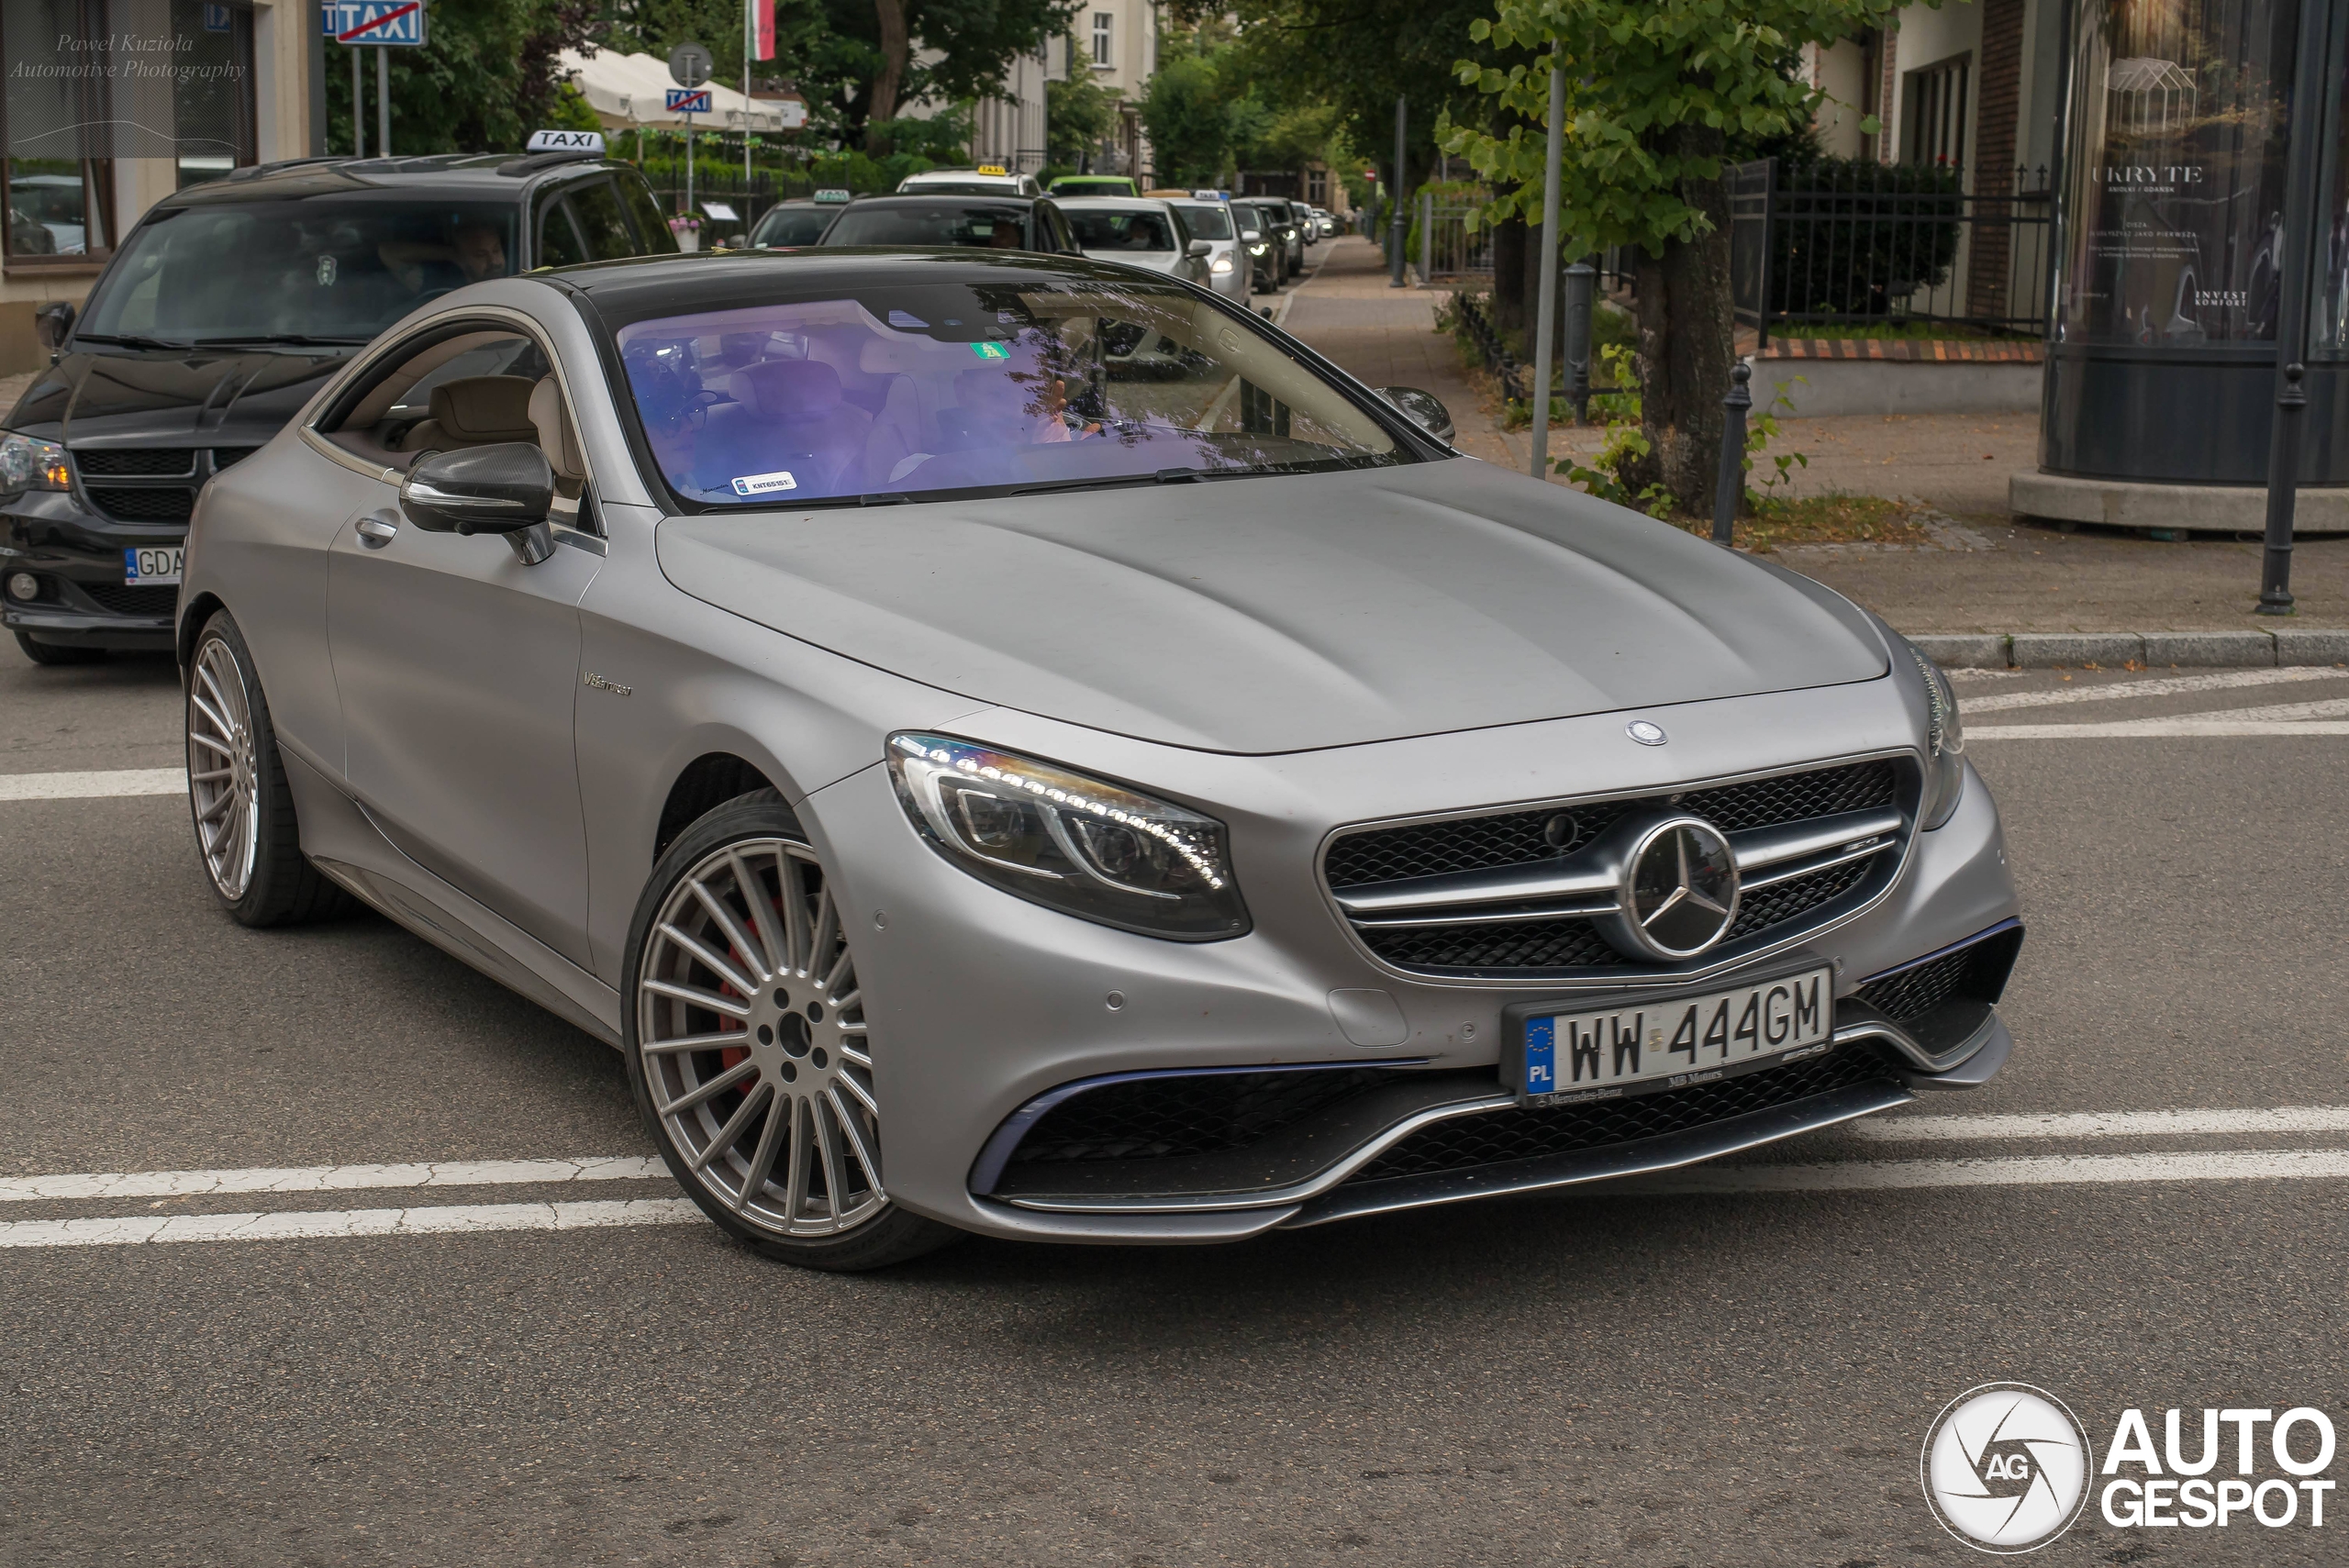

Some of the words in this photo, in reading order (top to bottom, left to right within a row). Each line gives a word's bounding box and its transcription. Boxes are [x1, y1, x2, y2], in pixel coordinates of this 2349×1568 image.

[339, 4, 417, 39] TAXI
[667, 92, 707, 111] TAXI
[540, 131, 594, 147] TAXI
[2091, 166, 2203, 183] UKRYTE
[2195, 290, 2248, 299] INVEST
[139, 550, 183, 575] GDA
[1567, 1010, 1645, 1083] WW
[1667, 974, 1821, 1065] 444GM
[1529, 1064, 1553, 1083] PL
[1667, 1075, 1687, 1088] MB
[1688, 1070, 1723, 1085] Motors
[1548, 1088, 1623, 1106] Mercedes-Benz
